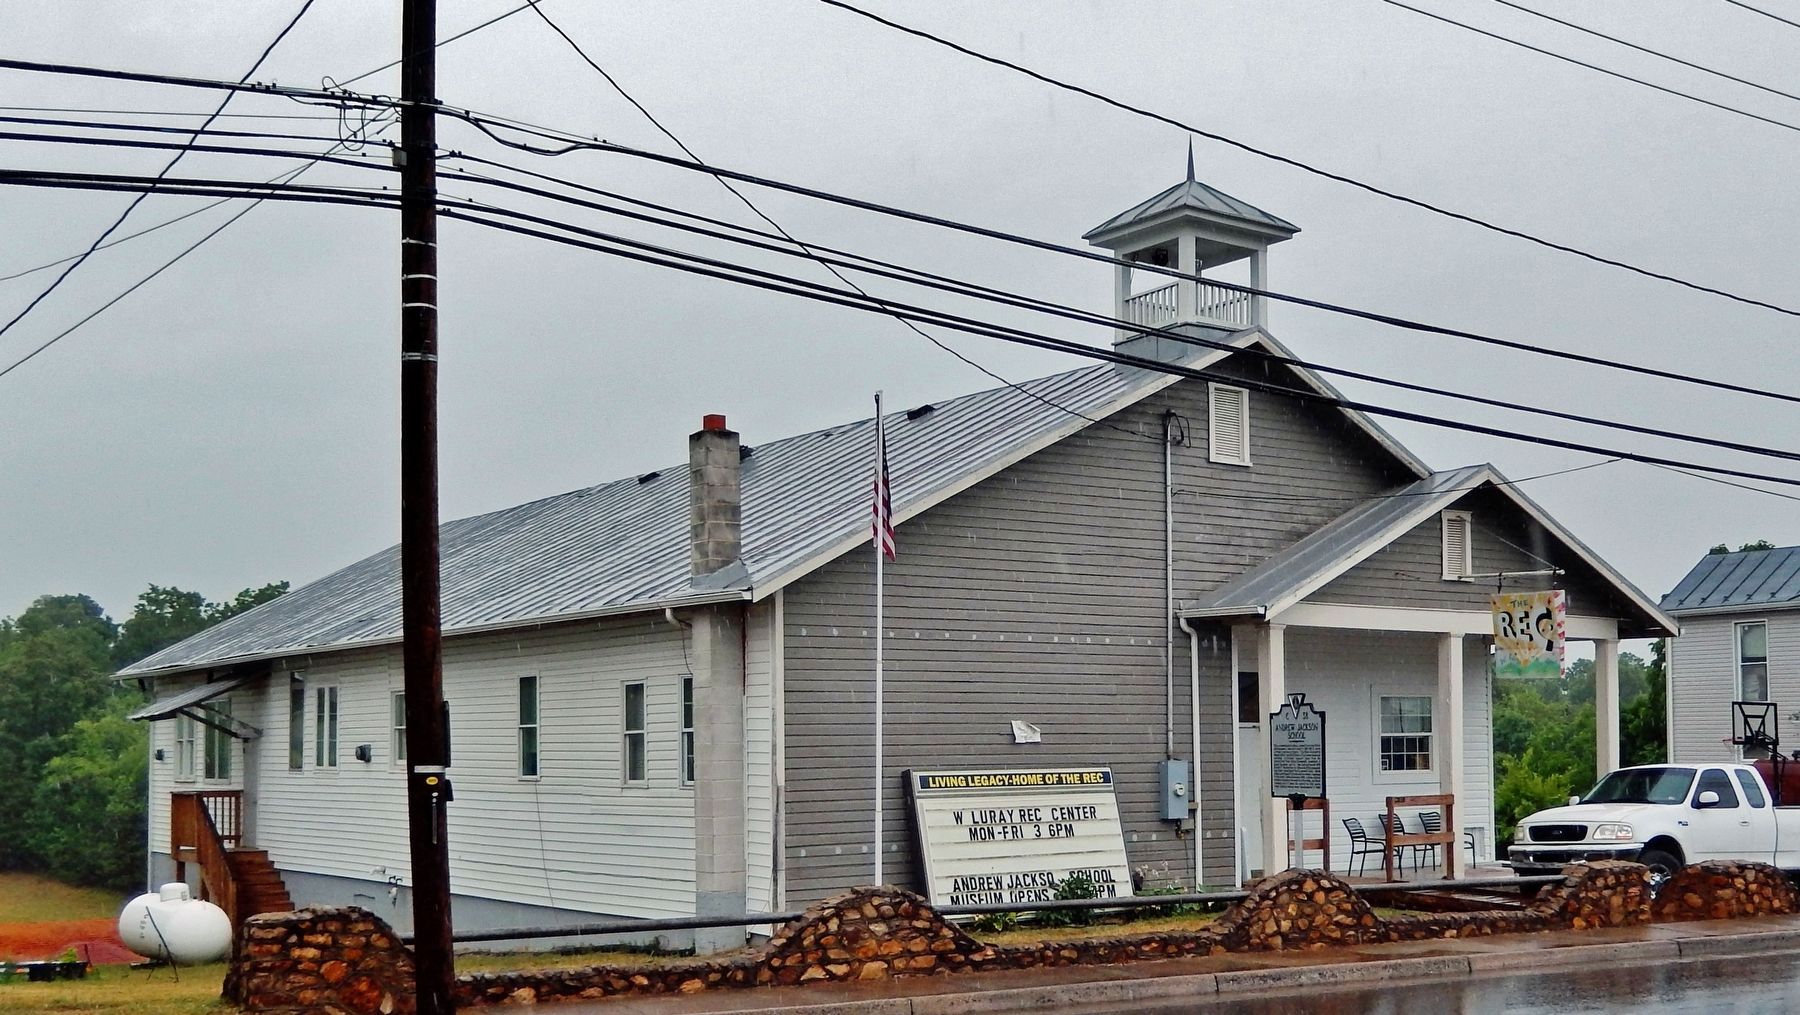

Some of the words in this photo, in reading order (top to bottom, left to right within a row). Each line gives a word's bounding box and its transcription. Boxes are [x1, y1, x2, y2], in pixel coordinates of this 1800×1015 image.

[1510, 600, 1529, 608] THE
[1496, 607, 1554, 652] REC
[1275, 723, 1296, 731] ANDREW
[1297, 722, 1318, 731] JACKSON
[1287, 731, 1306, 739] SCHOOL
[928, 776, 966, 788] LIVING
[968, 773, 1044, 787] LEGACY-HOME
[1045, 773, 1059, 785] OF
[1060, 772, 1081, 784] THE
[1082, 771, 1104, 783] REC
[953, 811, 963, 825] W
[971, 809, 1014, 825] LURAY
[1019, 808, 1042, 822] REC
[1051, 806, 1097, 821] CENTER
[968, 825, 1024, 841] MON-FRI
[1034, 824, 1042, 838] 3
[1049, 824, 1075, 838] 6PM
[952, 875, 1003, 893] ANDREW
[1069, 869, 1116, 886] SCHOOL
[950, 890, 1004, 906] MUSEUM
[1010, 888, 1050, 903] OPENS
